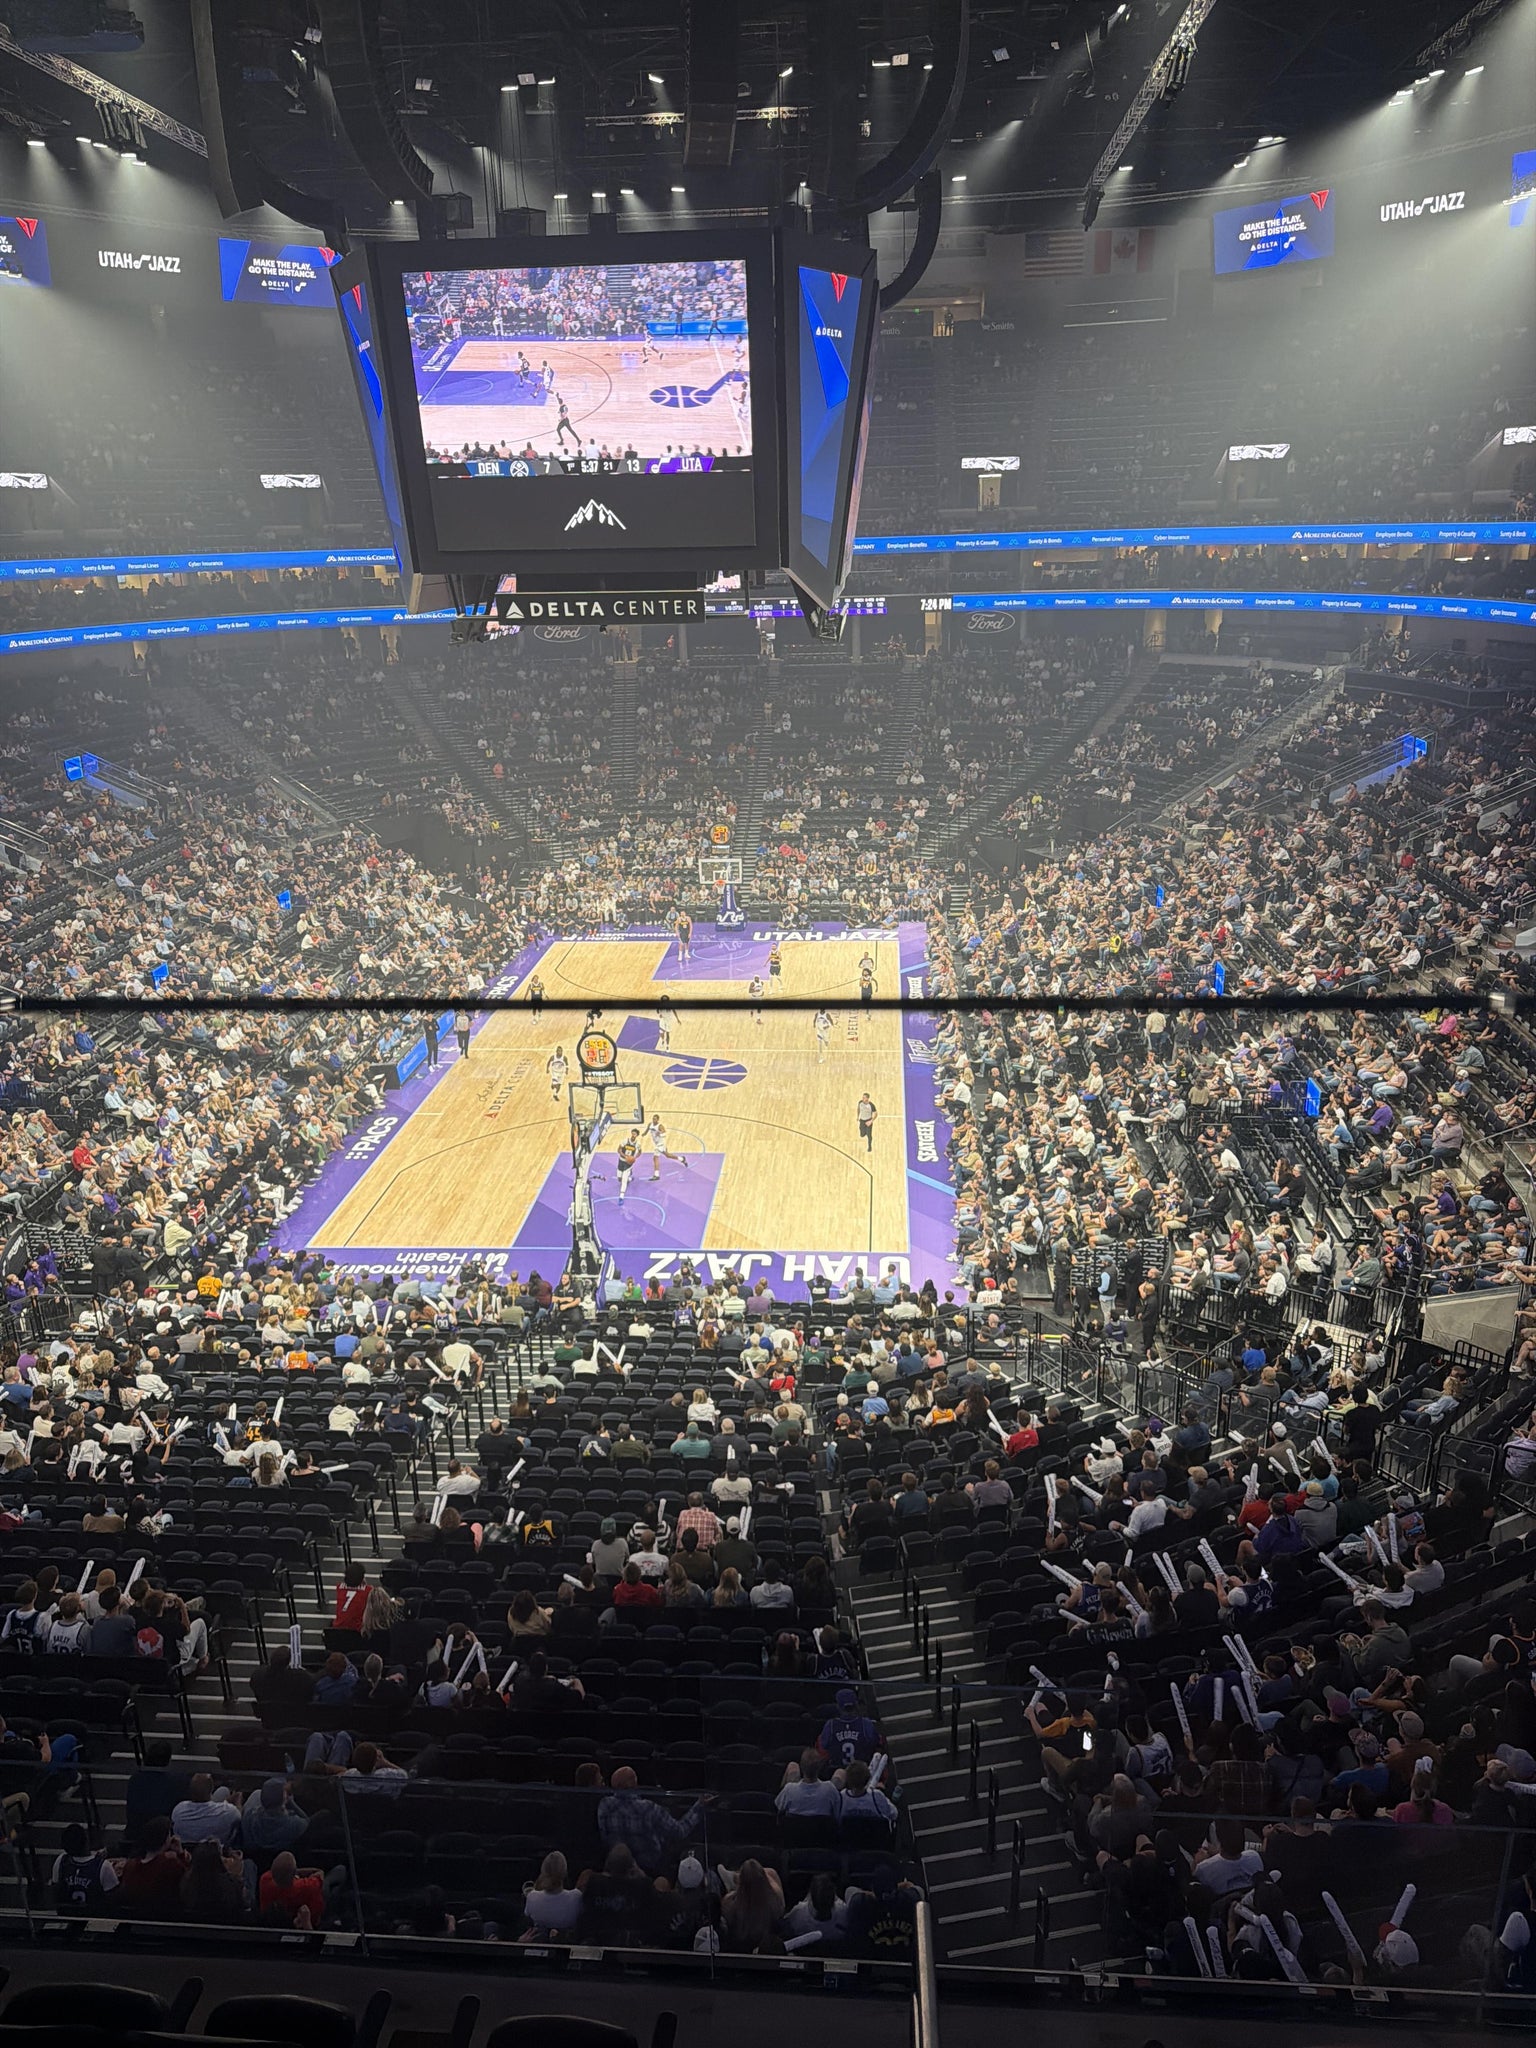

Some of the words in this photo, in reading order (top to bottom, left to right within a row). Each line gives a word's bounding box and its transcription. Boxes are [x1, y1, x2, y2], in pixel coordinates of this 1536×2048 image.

[1381, 200, 1414, 222] UTAH
[1430, 191, 1465, 213] JAZZ
[1239, 232, 1252, 240] GO
[1252, 229, 1266, 238] THE
[1268, 222, 1306, 236] DISTANCE.
[1244, 221, 1265, 232] MAKE
[1266, 218, 1280, 228] THE
[1282, 214, 1302, 225] PLAY.
[1257, 241, 1278, 250] DELTA
[98, 250, 132, 268] UTAH
[148, 255, 180, 272] JAZZ
[253, 258, 275, 268] MAKE
[276, 260, 291, 268] THE
[292, 261, 312, 270] PLAY.
[248, 266, 262, 274] GO
[262, 266, 277, 276] THE
[278, 268, 316, 278] DISTANCE.
[268, 280, 290, 288] DELTA
[822, 327, 842, 338] DELTA
[478, 462, 500, 474] DEN
[544, 462, 550, 474] 7
[581, 460, 598, 472] 5:37
[604, 462, 612, 470] 21
[627, 460, 640, 472] 13
[682, 458, 702, 470] UTA
[530, 602, 604, 616] DELTA
[614, 600, 698, 616] CENTER
[920, 599, 938, 610] 7:24
[939, 598, 952, 610] PM
[968, 613, 1004, 629] Ford
[544, 625, 580, 638] Ford
[753, 932, 823, 940] UTAH
[829, 932, 899, 940] JAZZ
[489, 1086, 515, 1110] DELTA
[508, 1058, 532, 1084] CENTER
[352, 1117, 398, 1151] PACS
[914, 1120, 939, 1162] SEATGEEK
[396, 1252, 468, 1263] Health
[643, 1252, 772, 1280] JAZZ
[783, 1254, 911, 1284] UTAH
[342, 1590, 357, 1612] 7
[17, 1638, 34, 1655] 13
[836, 1730, 859, 1742] GEORGE
[842, 1742, 855, 1765] 3
